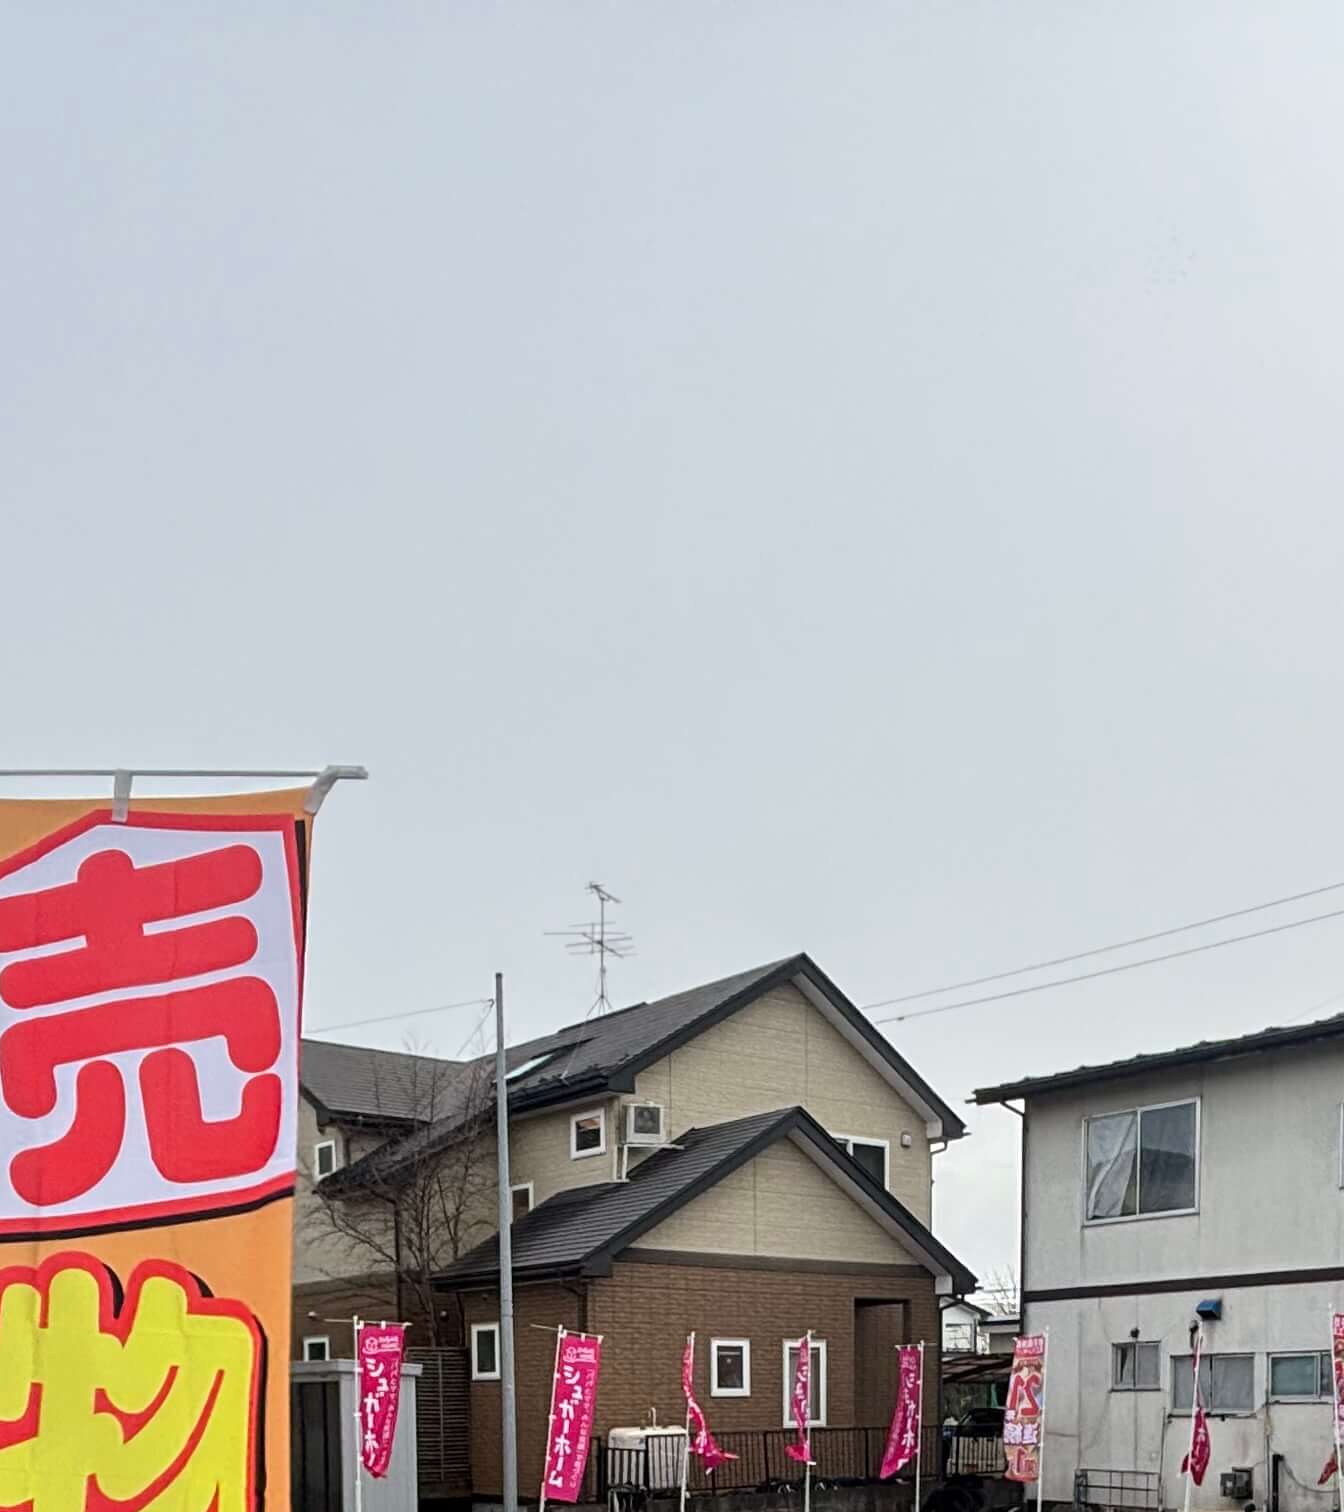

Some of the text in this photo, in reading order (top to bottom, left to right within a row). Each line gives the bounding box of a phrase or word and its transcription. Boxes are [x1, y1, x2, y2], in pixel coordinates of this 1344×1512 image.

[363, 1357, 390, 1467] シュガーホー
[548, 1365, 584, 1489] シュガーホーム
